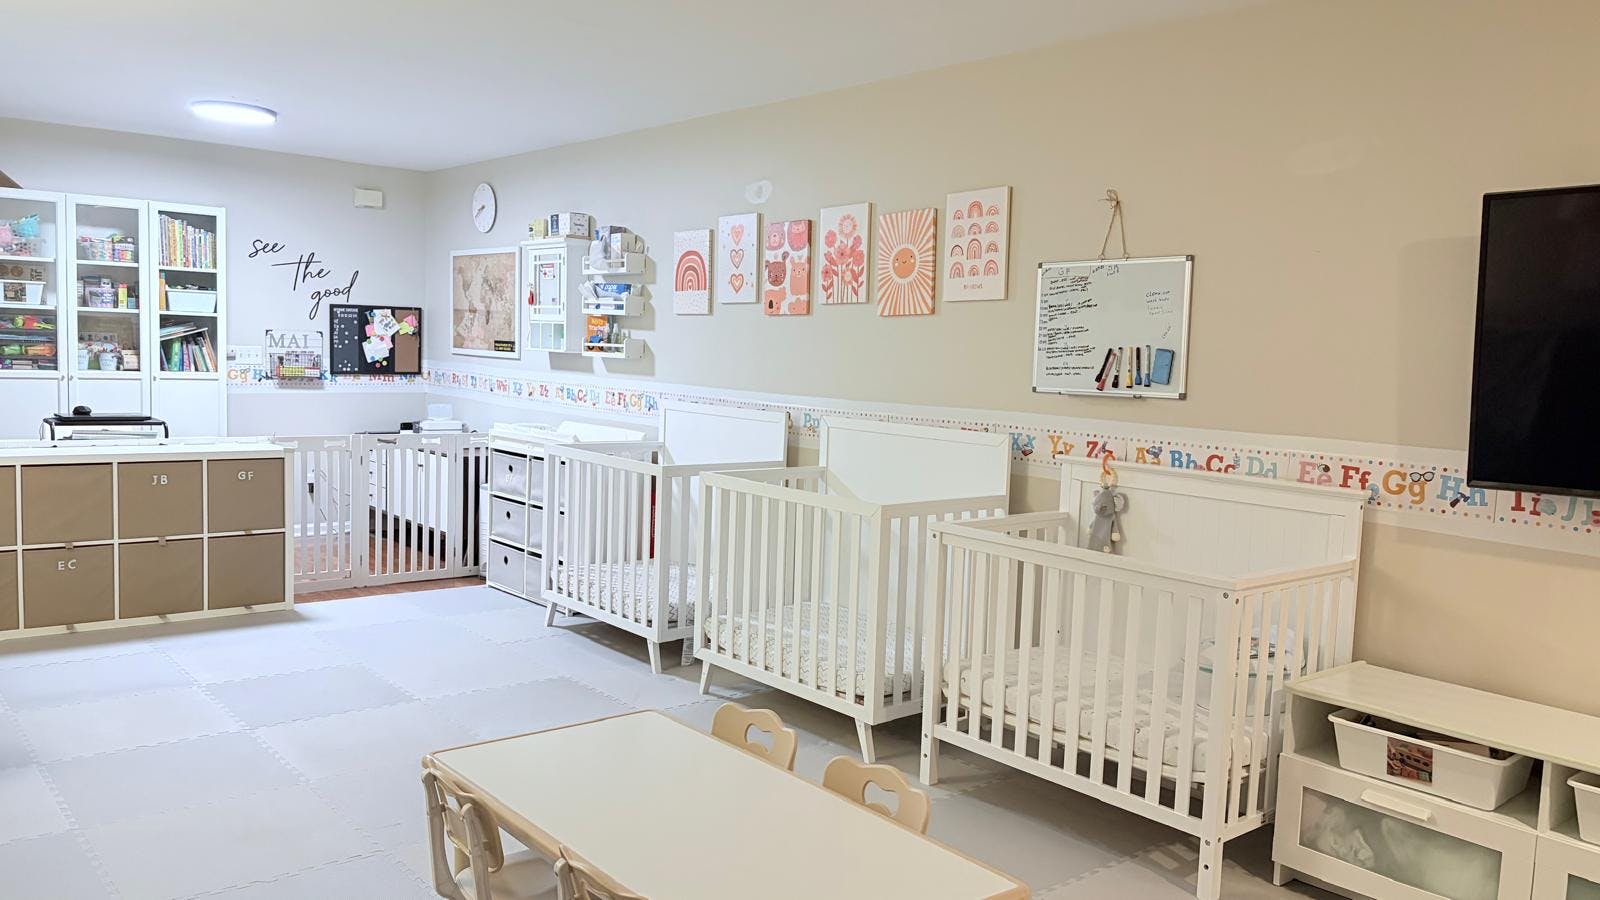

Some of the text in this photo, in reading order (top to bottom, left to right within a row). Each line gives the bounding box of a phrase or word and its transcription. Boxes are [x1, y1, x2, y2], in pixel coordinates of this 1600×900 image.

[248, 239, 286, 258] see
[309, 270, 359, 320] good
[268, 333, 309, 349] MAI
[151, 474, 168, 486] JB
[237, 471, 254, 481] GF
[1169, 450, 1200, 470] Bb
[1245, 456, 1278, 479] Dd
[1297, 461, 1333, 485] Ee
[1338, 464, 1371, 490] Ff
[1382, 469, 1427, 505] Gg
[58, 559, 77, 571] EC
